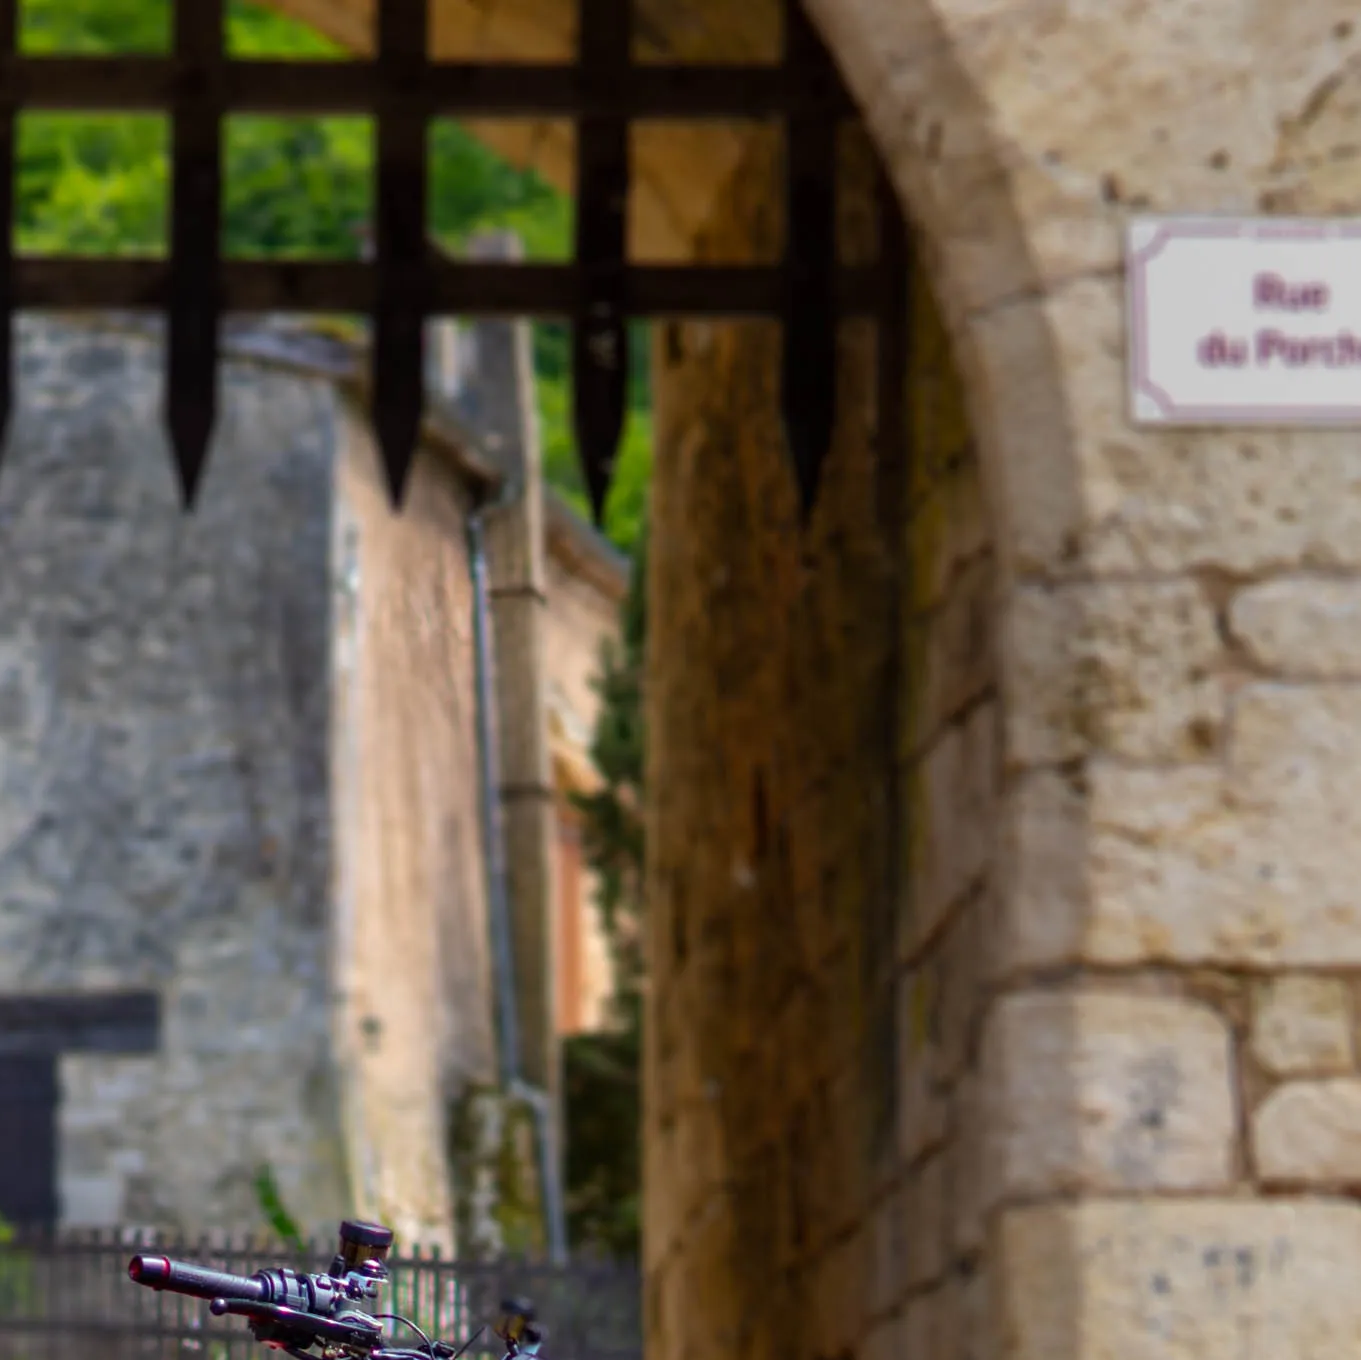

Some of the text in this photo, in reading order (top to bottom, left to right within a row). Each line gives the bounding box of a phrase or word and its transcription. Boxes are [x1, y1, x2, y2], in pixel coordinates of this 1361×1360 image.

[1252, 271, 1330, 312] Rue
[1196, 328, 1361, 368] du Porch
